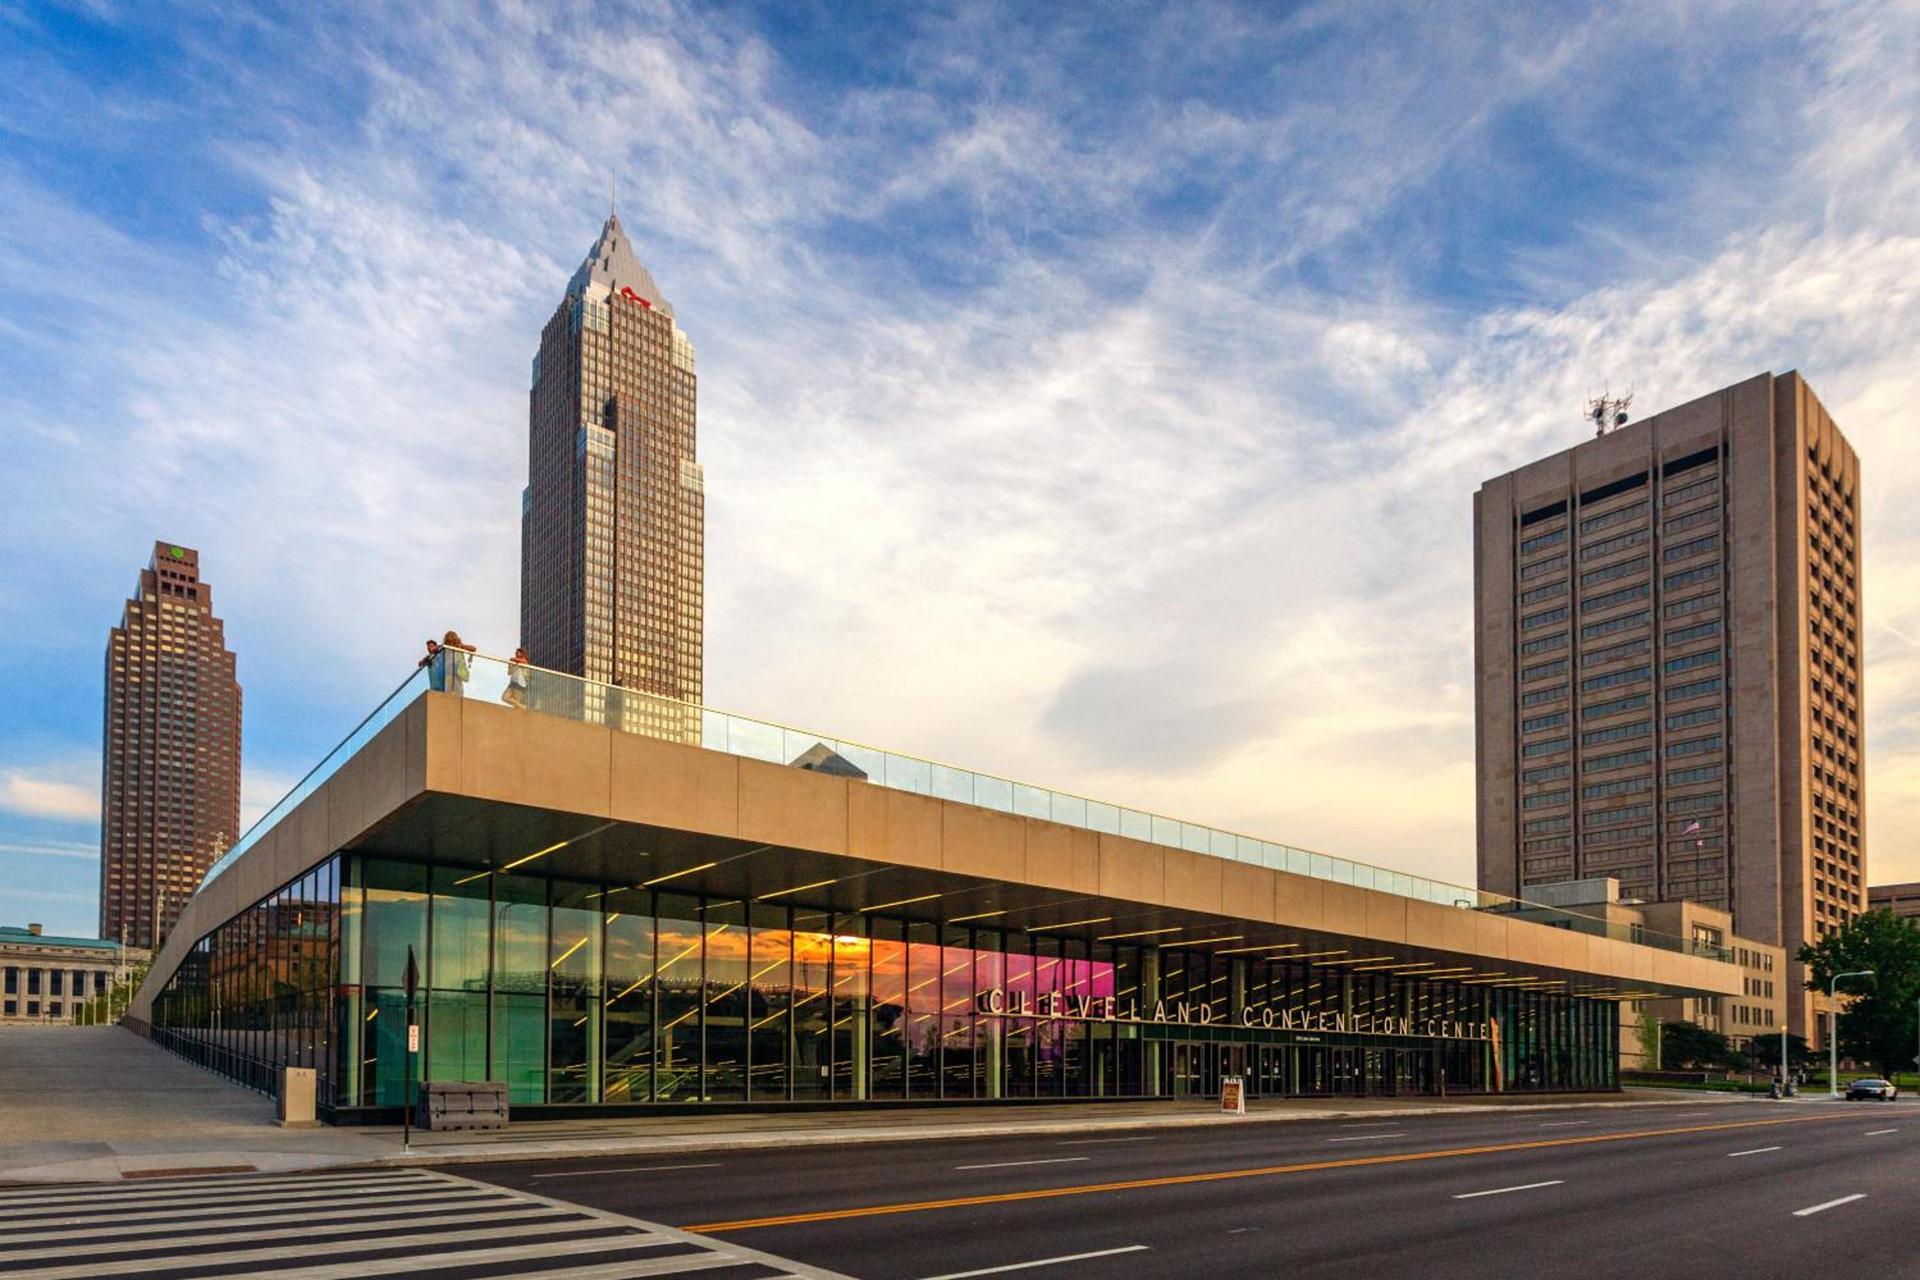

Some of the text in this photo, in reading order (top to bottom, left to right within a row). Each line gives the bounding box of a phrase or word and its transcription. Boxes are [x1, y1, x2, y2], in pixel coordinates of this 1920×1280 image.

[989, 988, 1499, 1040] CLEVELAND CONVENTION CENTE
